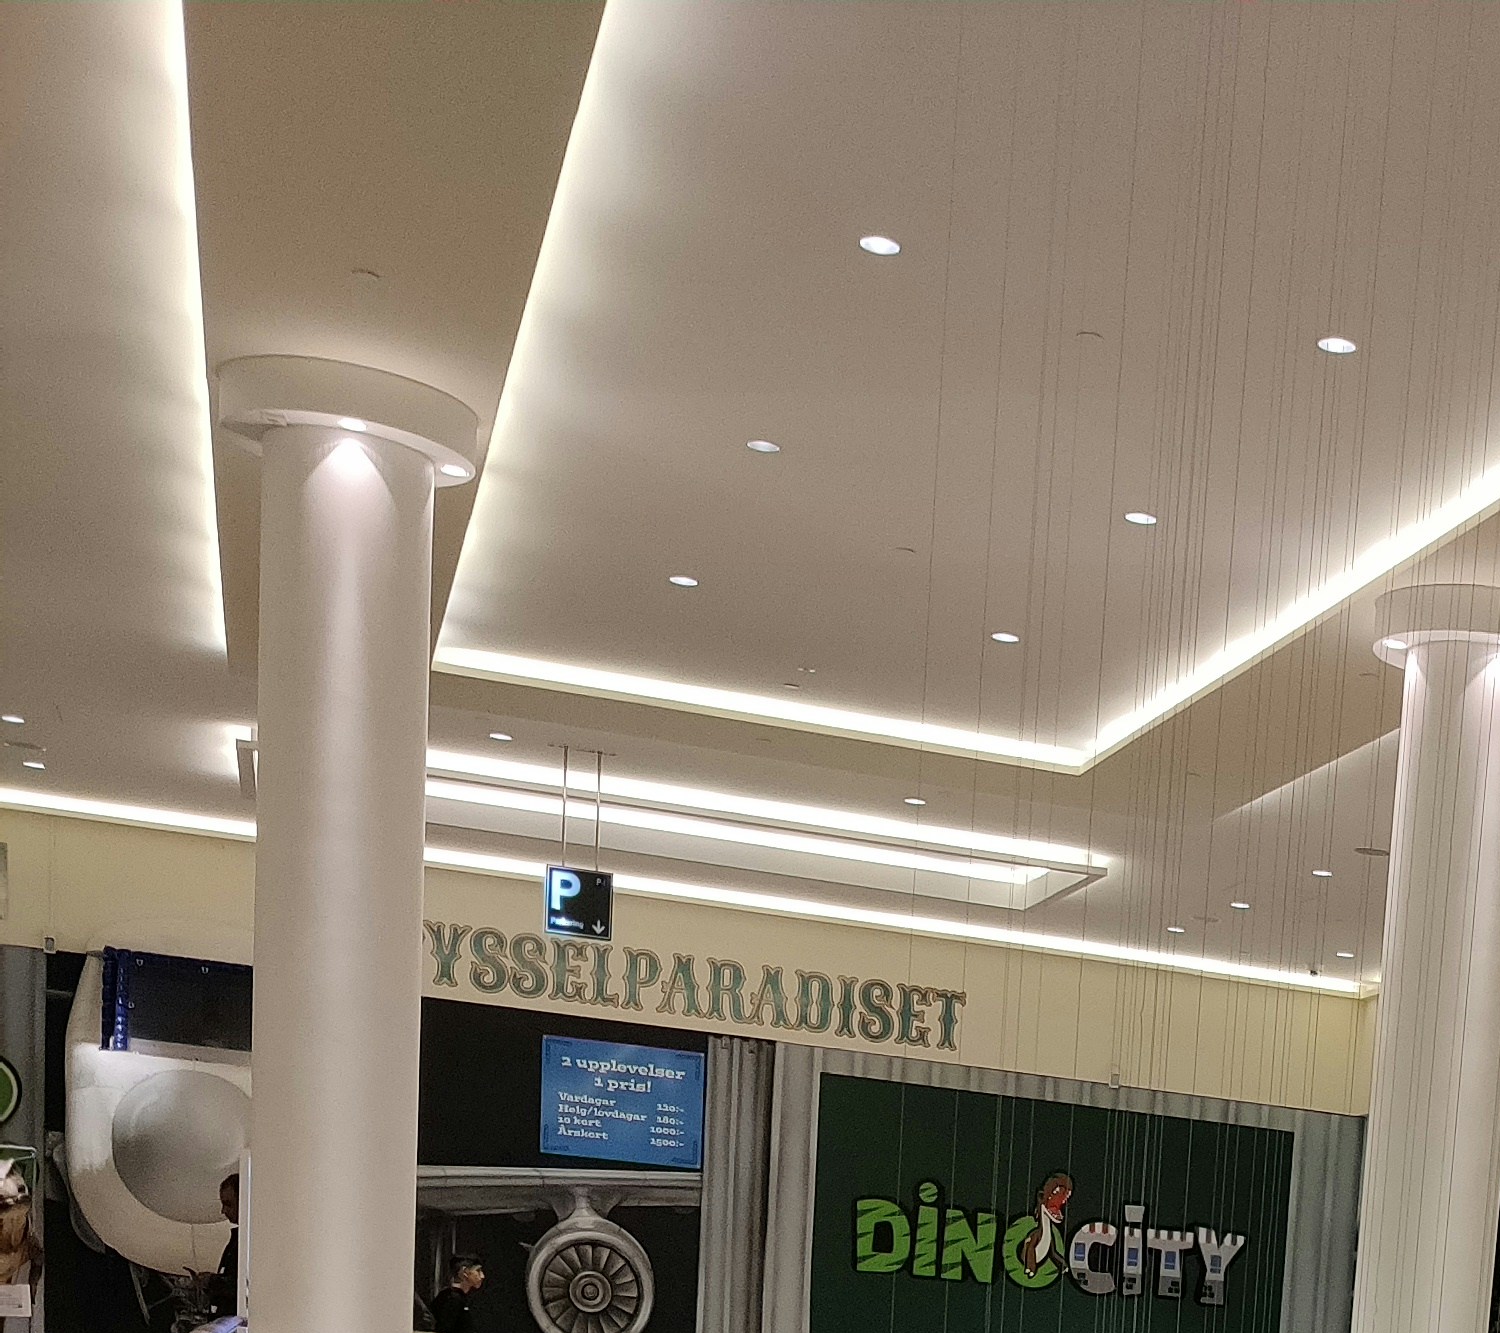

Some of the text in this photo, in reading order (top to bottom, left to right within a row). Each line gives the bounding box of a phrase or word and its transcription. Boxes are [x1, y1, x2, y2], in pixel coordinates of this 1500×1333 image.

[551, 870, 581, 911] P
[422, 918, 967, 1052] YSSELPARADISET
[561, 1056, 686, 1081] 2 upplevelser
[594, 1076, 652, 1094] 1 pris!
[558, 1091, 617, 1108] Vardagar
[558, 1103, 648, 1123] Helg/lovdagar
[573, 1117, 602, 1128] kort
[557, 1124, 609, 1141] Årskort
